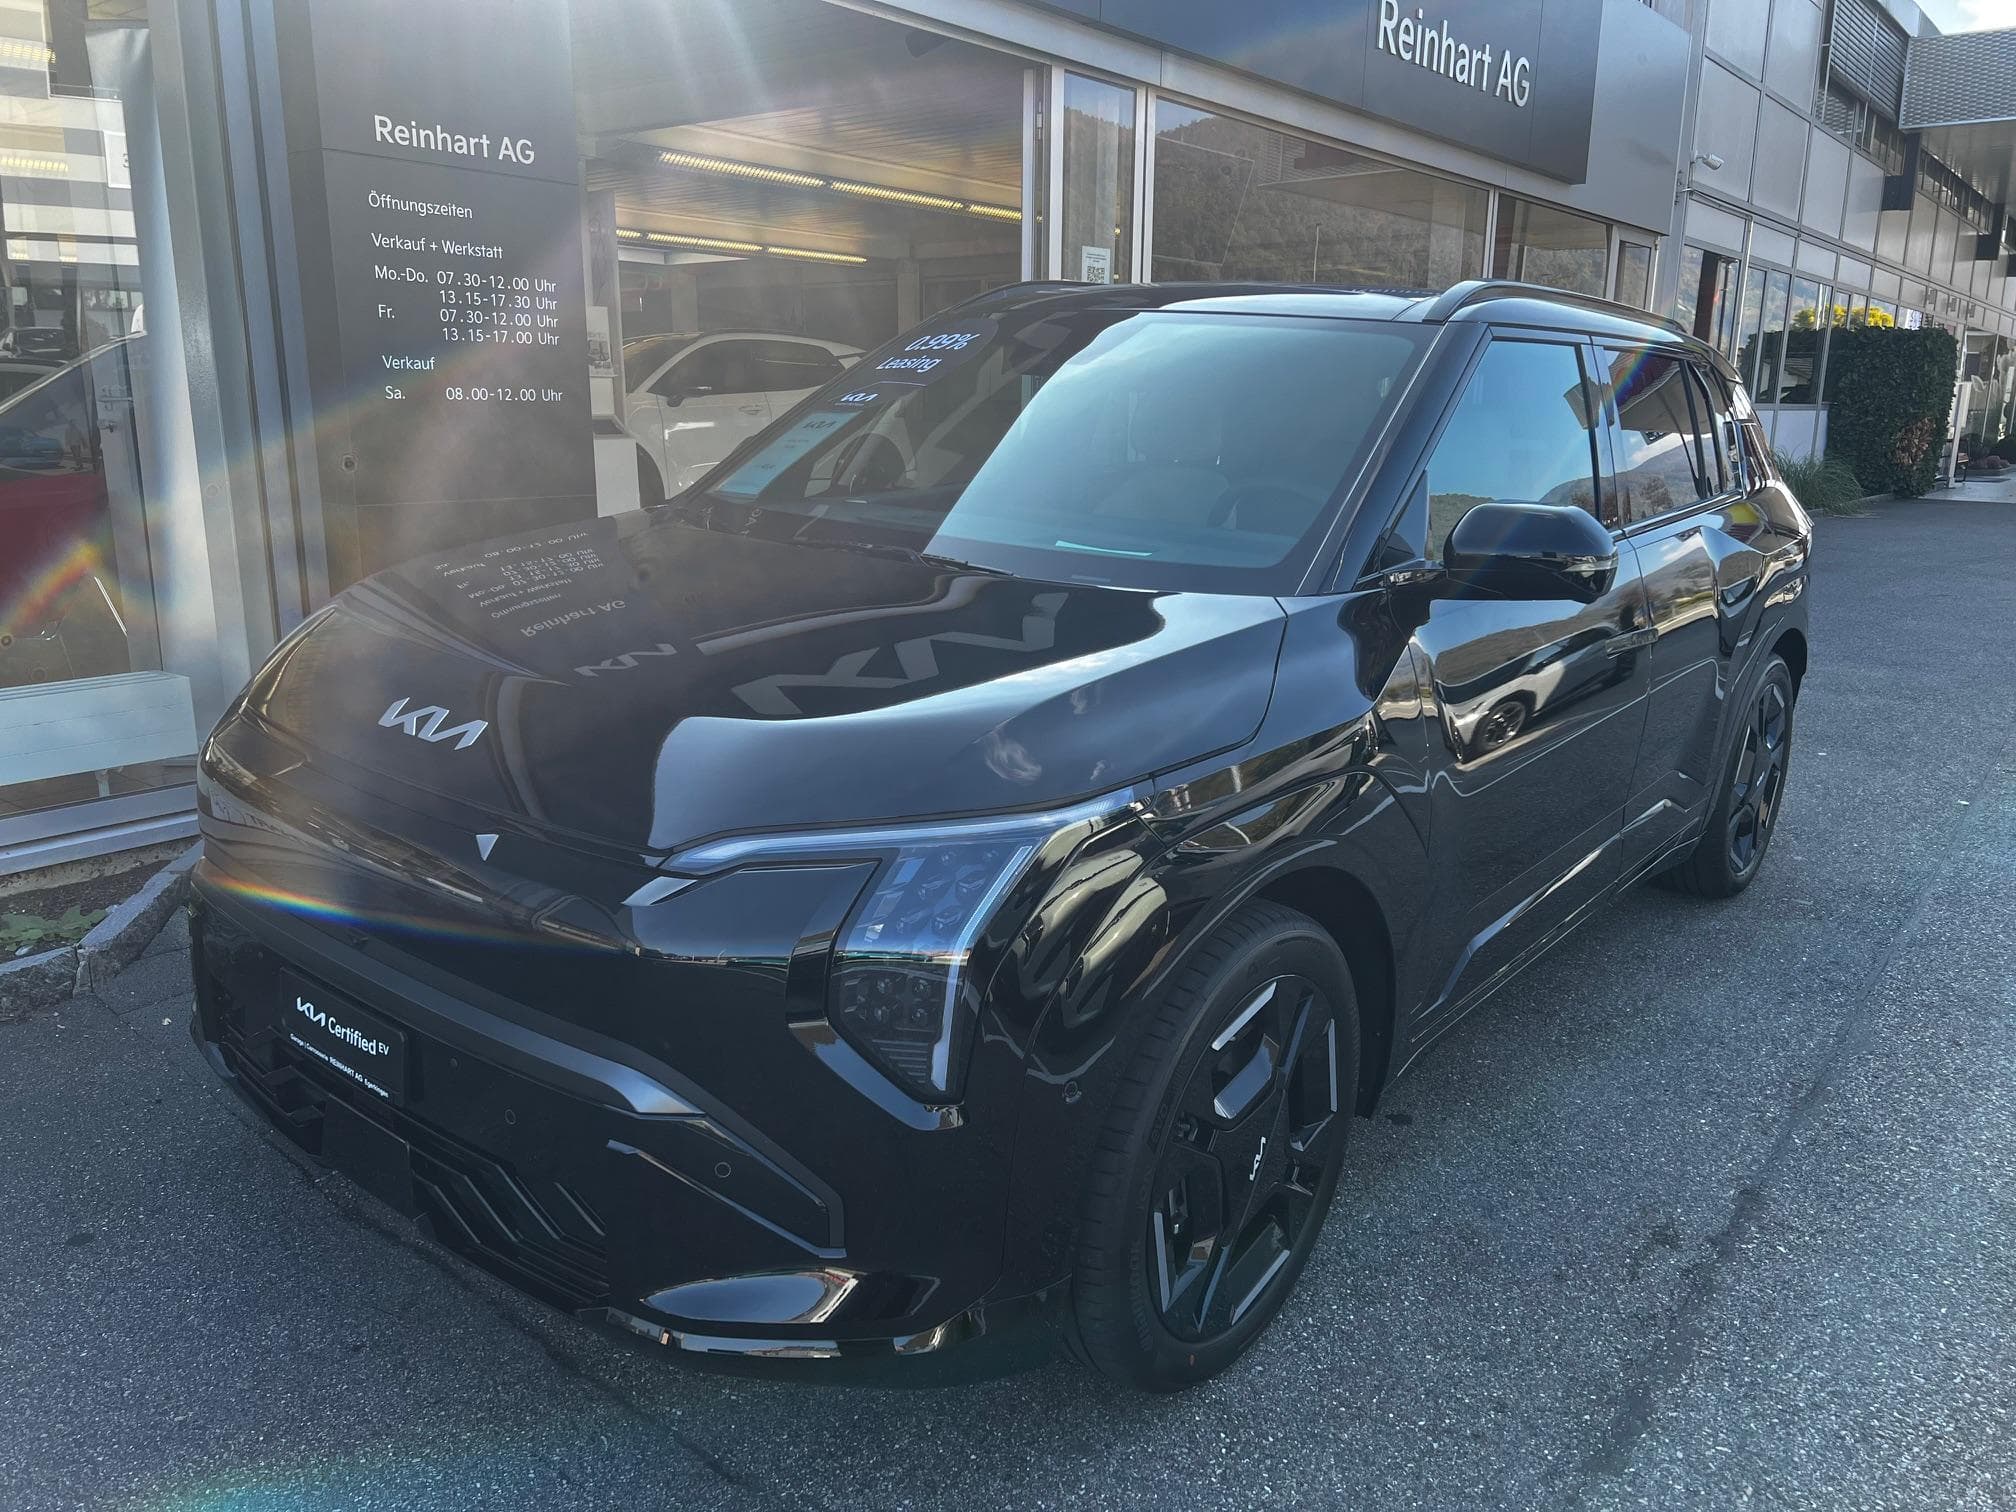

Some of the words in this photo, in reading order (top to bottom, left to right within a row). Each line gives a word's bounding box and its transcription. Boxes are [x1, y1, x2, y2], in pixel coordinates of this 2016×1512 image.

[1378, 0, 1492, 92] Reinhart
[1496, 50, 1530, 107] AG
[373, 114, 490, 158] Reinhart
[498, 138, 535, 165] AG
[368, 190, 473, 219] Öffnungszeiten
[371, 232, 425, 252] Verkauf
[430, 241, 438, 251] +
[441, 239, 503, 260] Werkstatt
[374, 264, 428, 284] Mo.-Do.
[535, 278, 556, 293] Uhr
[378, 304, 395, 319] Fr.
[537, 315, 558, 329] Uhr
[536, 297, 557, 311] Uhr
[538, 332, 559, 346] Uhr
[905, 333, 980, 351] 0.99%
[382, 355, 435, 371] Verkauf
[876, 354, 942, 373] Leasing
[385, 386, 406, 400] Sa.
[542, 389, 562, 402] Uhr
[328, 1016, 376, 1055] Certified
[378, 1042, 390, 1055] EV
